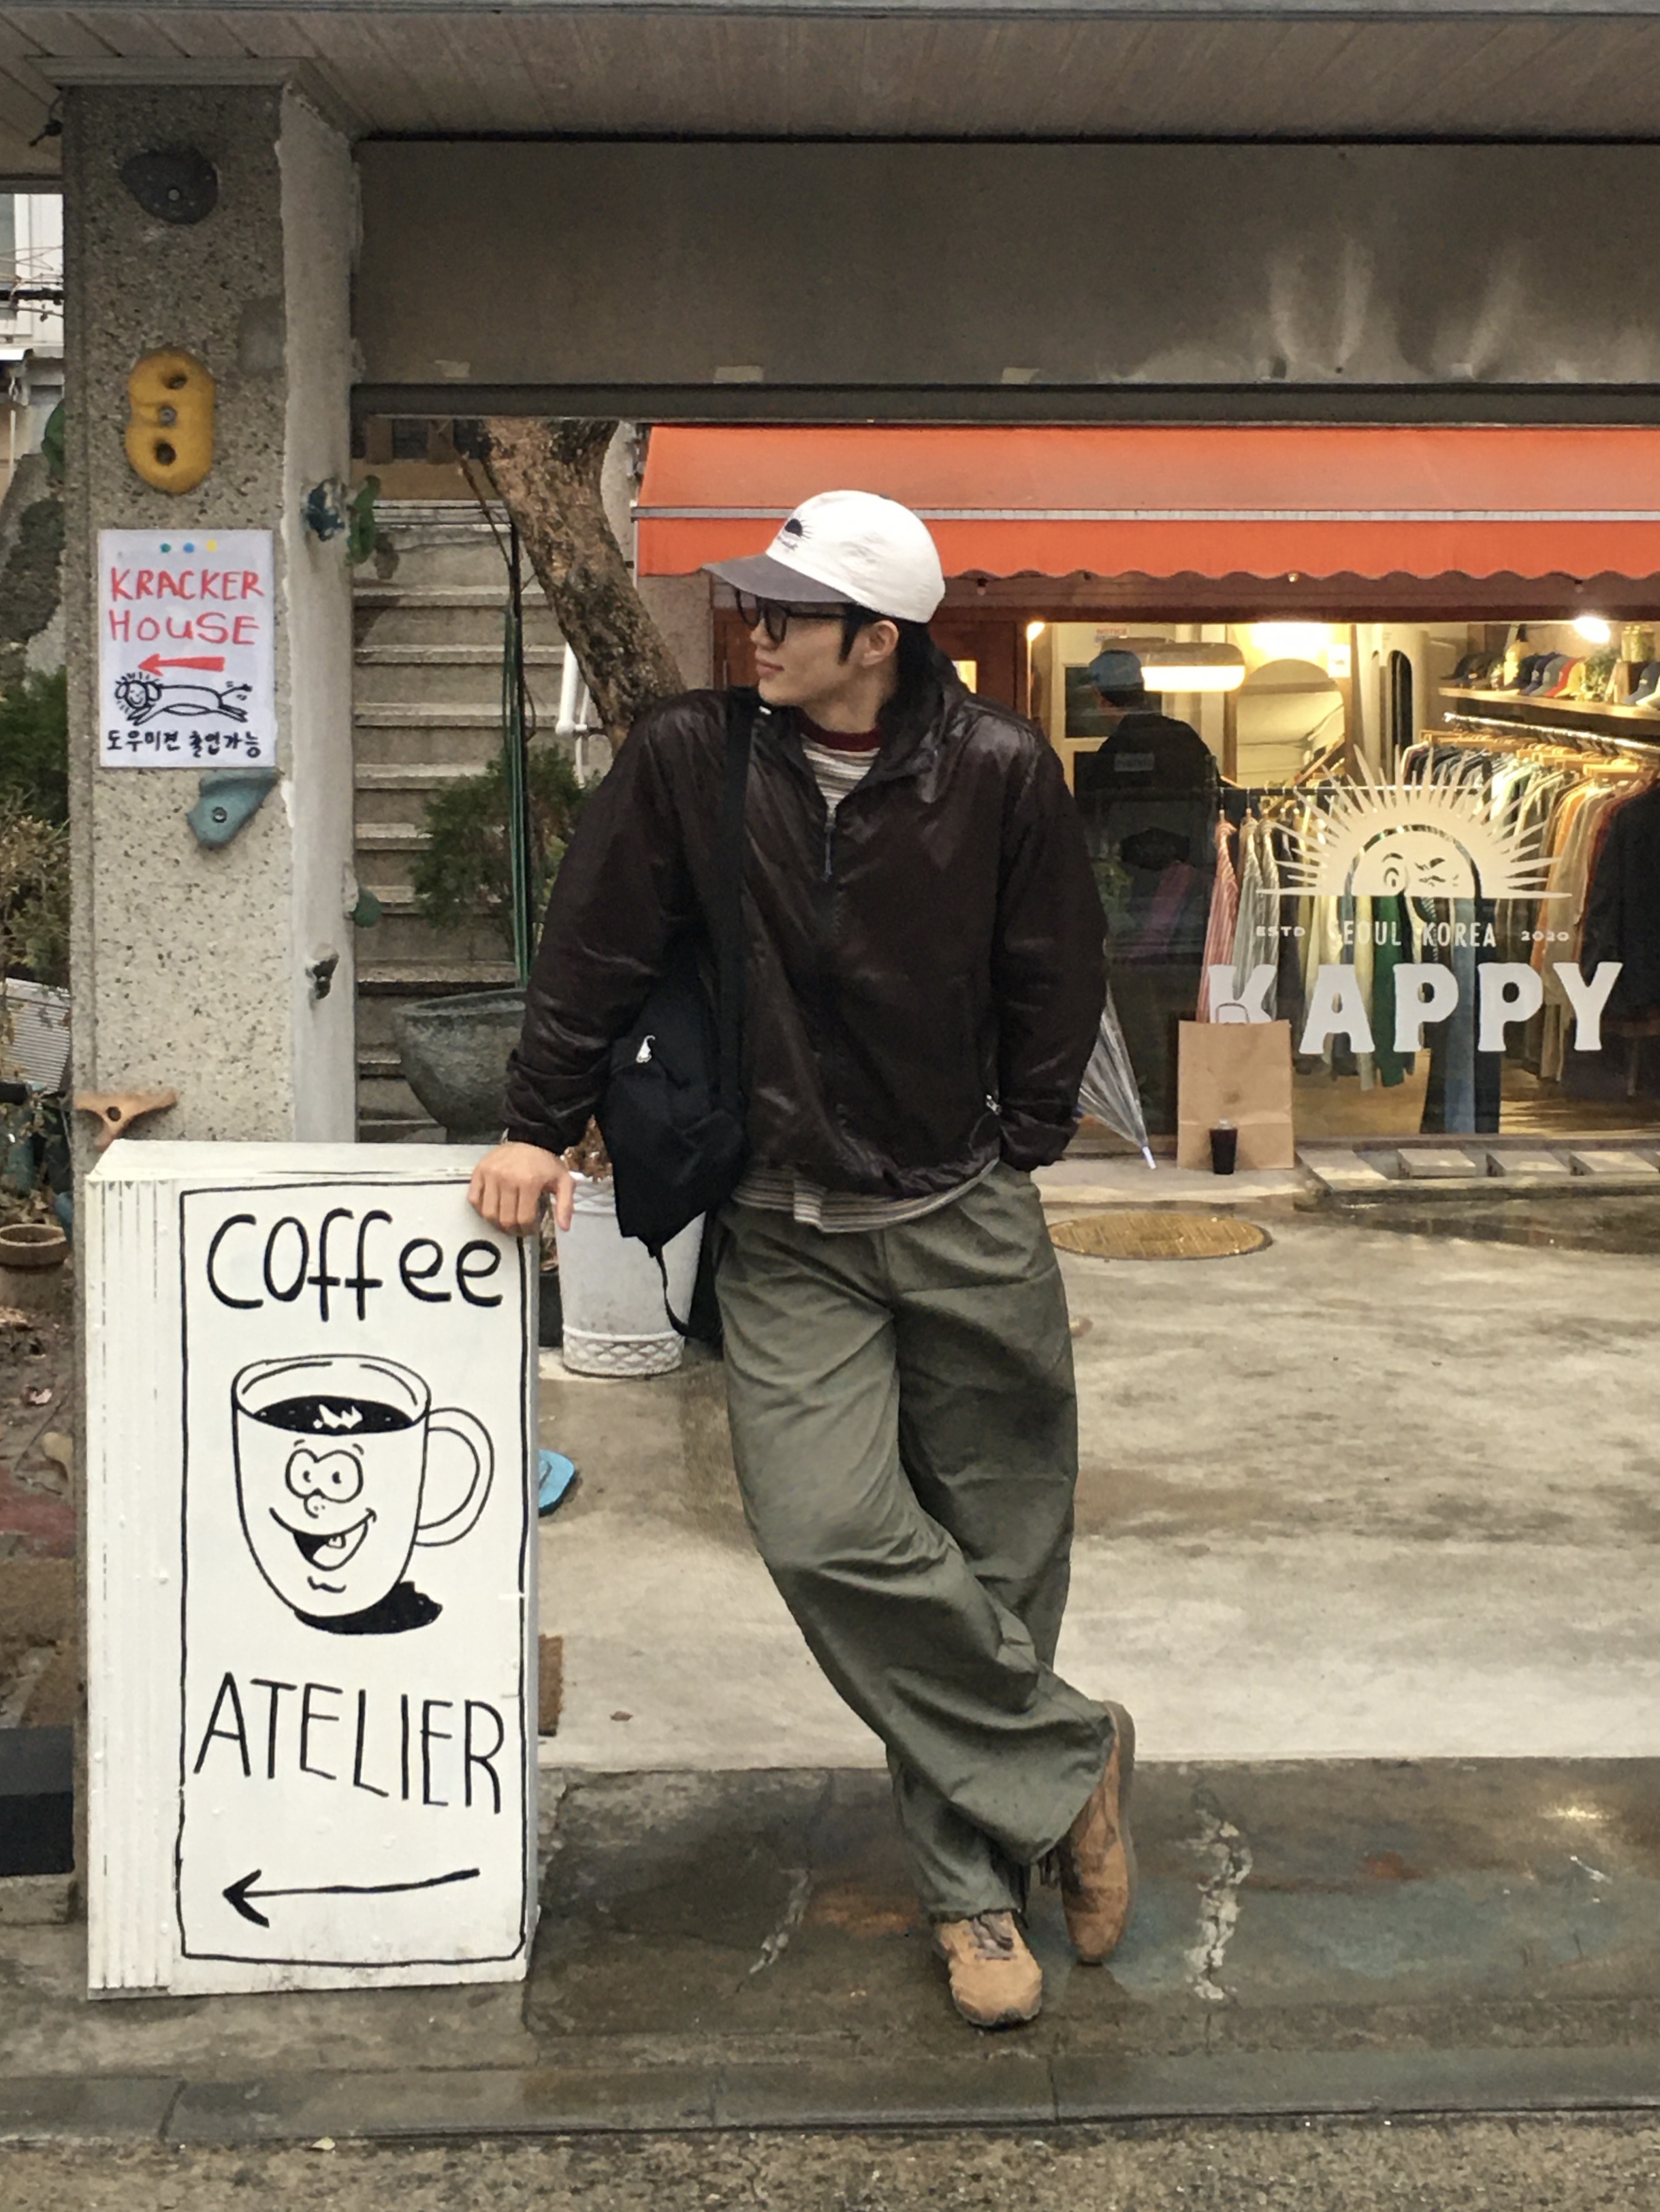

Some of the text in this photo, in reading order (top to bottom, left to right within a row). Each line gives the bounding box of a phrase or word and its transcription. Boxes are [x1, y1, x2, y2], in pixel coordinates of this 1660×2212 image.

[110, 566, 264, 602] KRACKER
[109, 610, 259, 645] HOUSE
[106, 730, 180, 752] 도우미견
[1256, 926, 1305, 937] ESTD
[1422, 922, 1497, 947] KOREA
[1520, 931, 1569, 942] 2020
[1208, 961, 1624, 1054] KAPPY
[193, 1671, 505, 1814] ATELIER
